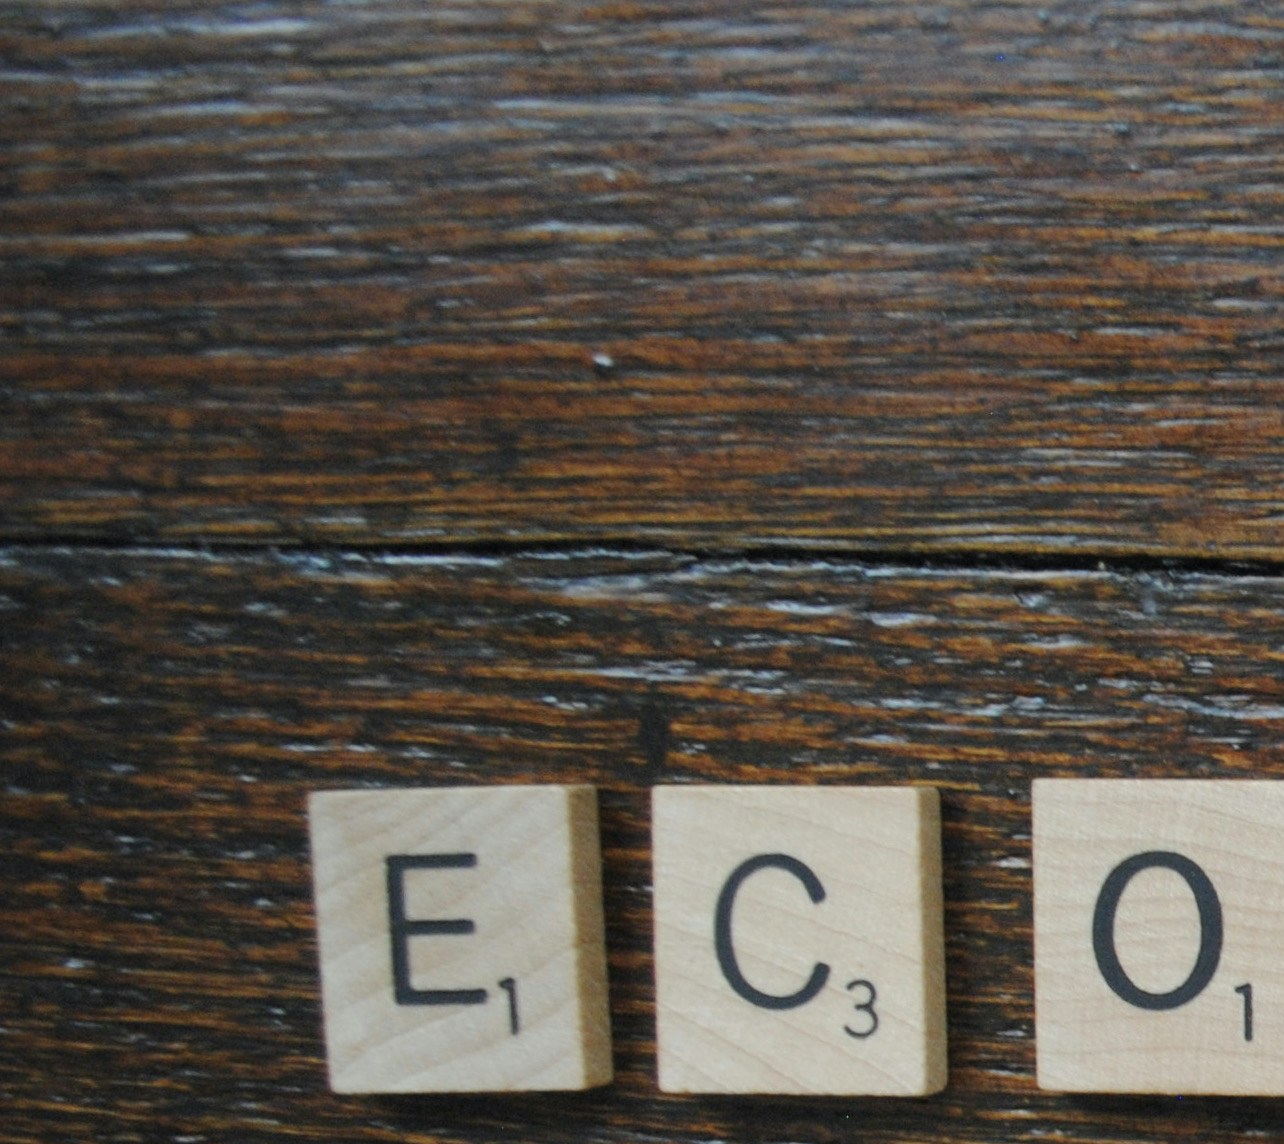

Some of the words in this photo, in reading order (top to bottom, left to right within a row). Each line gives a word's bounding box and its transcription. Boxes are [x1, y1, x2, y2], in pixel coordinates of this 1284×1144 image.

[495, 976, 522, 1036] 1
[842, 978, 881, 1039] 3
[1232, 982, 1255, 1043] 1
